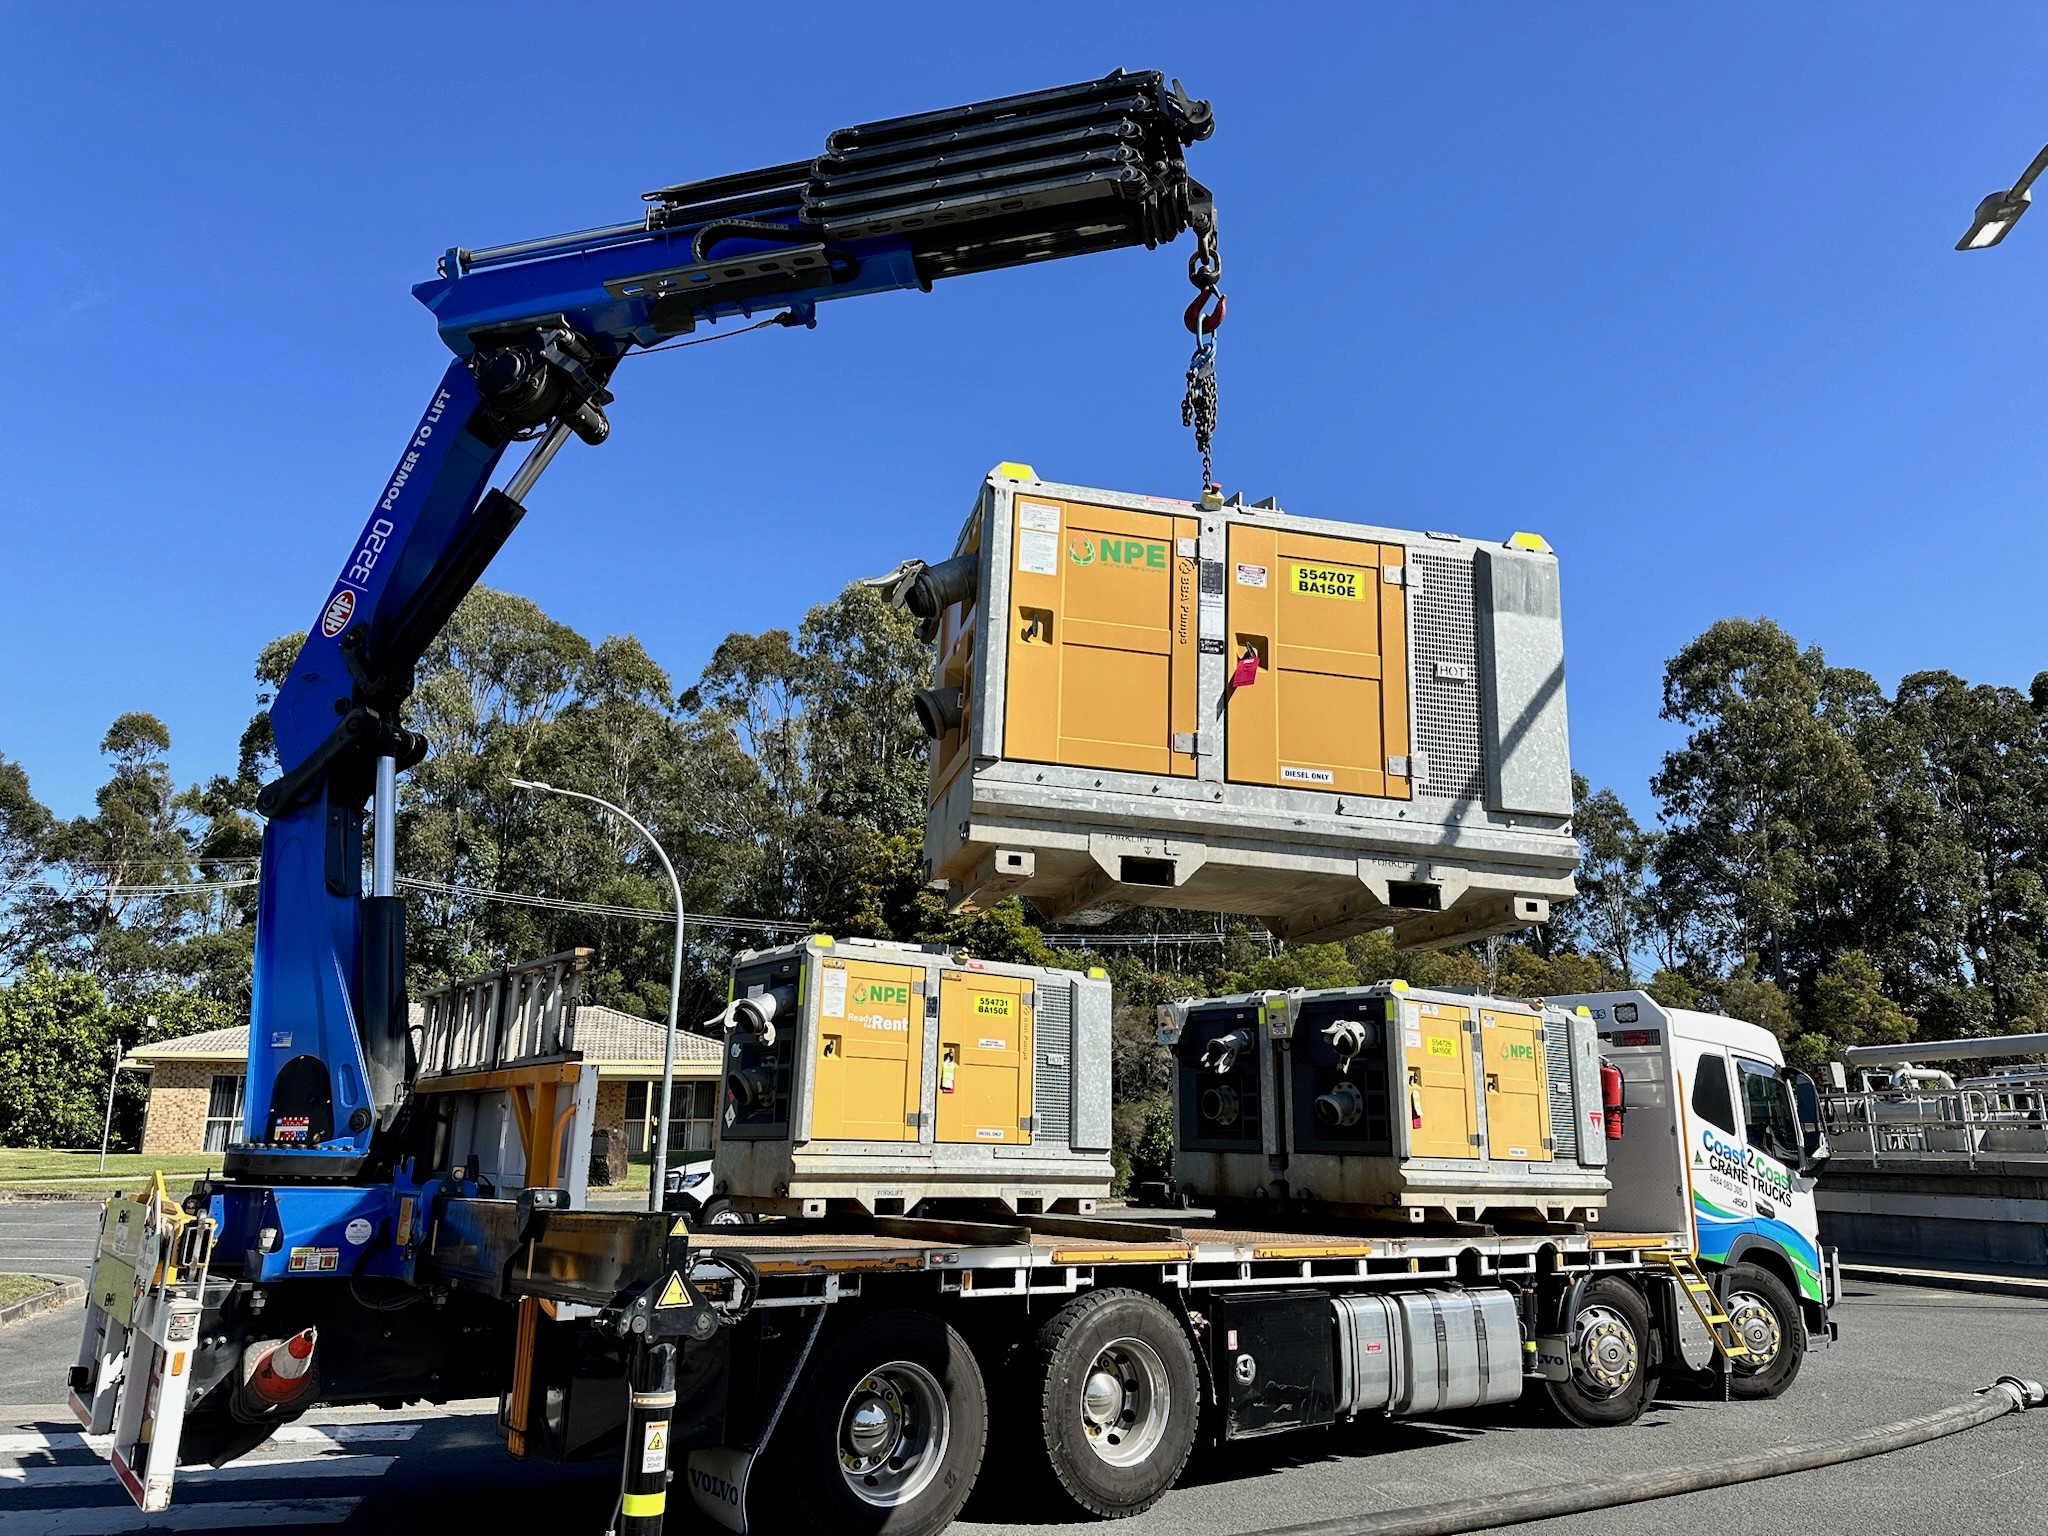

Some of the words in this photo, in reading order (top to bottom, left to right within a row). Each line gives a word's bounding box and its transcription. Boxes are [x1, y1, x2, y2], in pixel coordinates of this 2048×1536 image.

[381, 450, 421, 511] POWER
[413, 425, 433, 449] TO
[426, 388, 452, 424] LIFT
[348, 518, 395, 584] 3220
[1100, 538, 1166, 568] NPE
[1299, 568, 1356, 585] 554707
[1180, 576, 1190, 605] BBA
[1298, 580, 1356, 597] BA150E
[326, 594, 354, 632] HMF
[1178, 605, 1190, 645] Pumps
[1439, 664, 1466, 678] HOT
[1284, 769, 1310, 780] DIESEL
[1311, 771, 1331, 781] ONLY
[1104, 832, 1152, 844] FORKLIFT
[1372, 857, 1417, 869] FORKLIFT
[870, 985, 908, 1004] NPE
[979, 997, 1009, 1007] 554731
[847, 1012, 873, 1024] Ready
[978, 1005, 1009, 1015] BA150E
[871, 1014, 909, 1032] Rent
[1431, 1038, 1452, 1048] 554726
[1049, 1055, 1063, 1064] HOT
[1510, 1044, 1533, 1060] NPE
[1702, 1129, 1747, 1171] Coast
[1747, 1148, 1755, 1169] 2
[1755, 1156, 1793, 1194] Coast
[1709, 1155, 1749, 1186] CRANE
[1750, 1174, 1792, 1208] TRUCKS
[877, 1189, 903, 1197] FORKLIFT
[1732, 1197, 1748, 1209] 450
[1538, 1354, 1564, 1365] LVO
[689, 1467, 739, 1506] VOLVO
